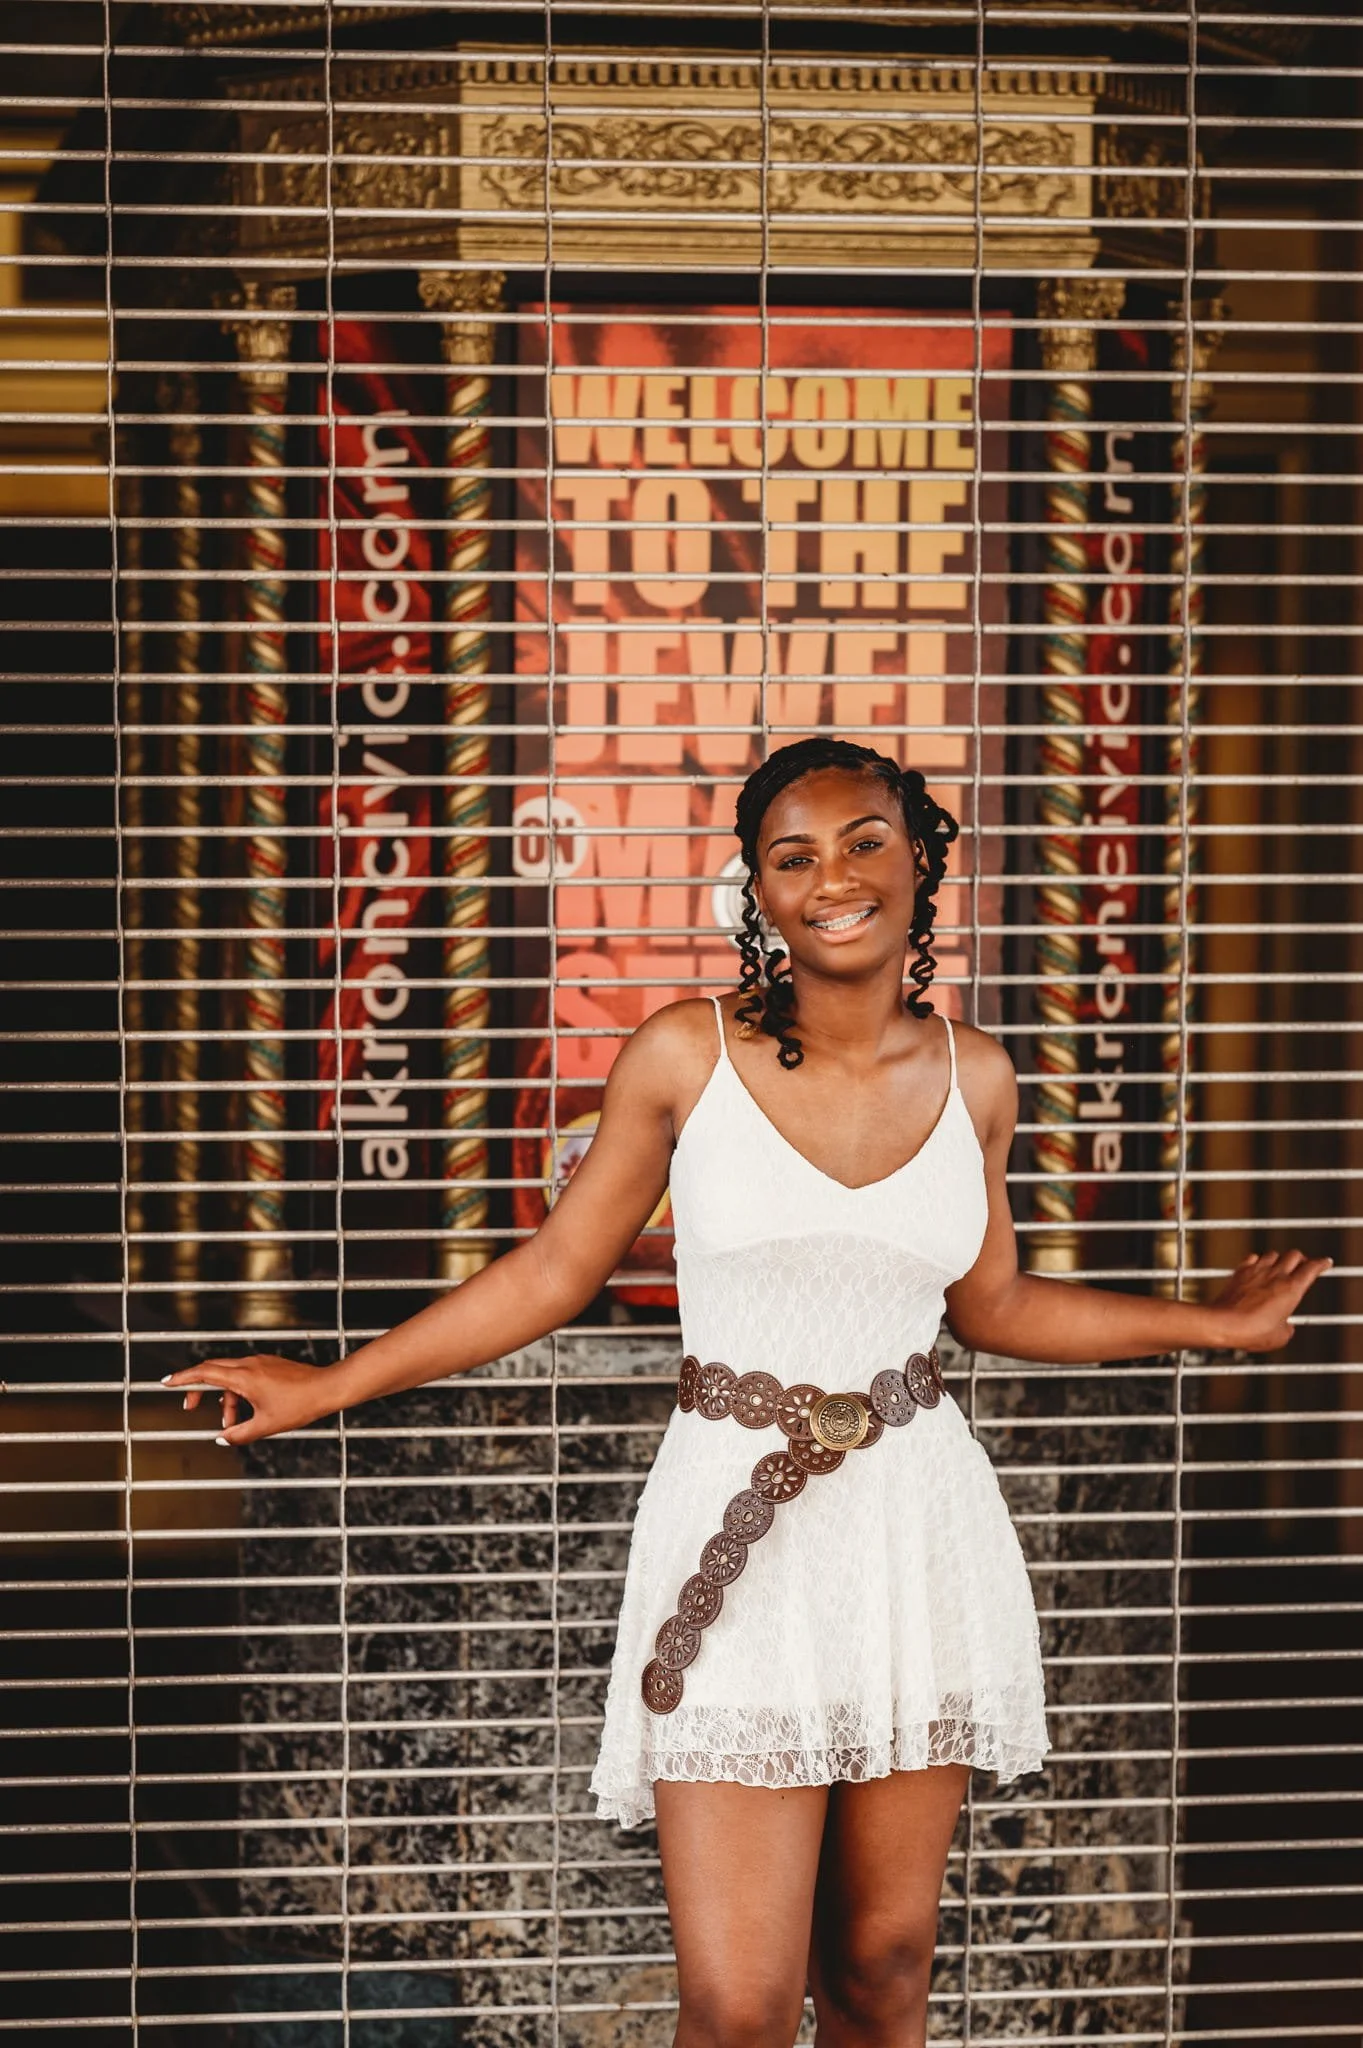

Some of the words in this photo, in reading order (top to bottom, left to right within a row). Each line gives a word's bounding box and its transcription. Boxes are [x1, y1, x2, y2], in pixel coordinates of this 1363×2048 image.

[551, 374, 972, 469] WELCOME
[555, 474, 711, 609] TO
[743, 476, 967, 610] THE
[555, 617, 967, 767] JEWEL
[331, 409, 411, 1179] akroncivic.com
[519, 816, 576, 866] ON
[1079, 424, 1135, 1173] akroncivic.com
